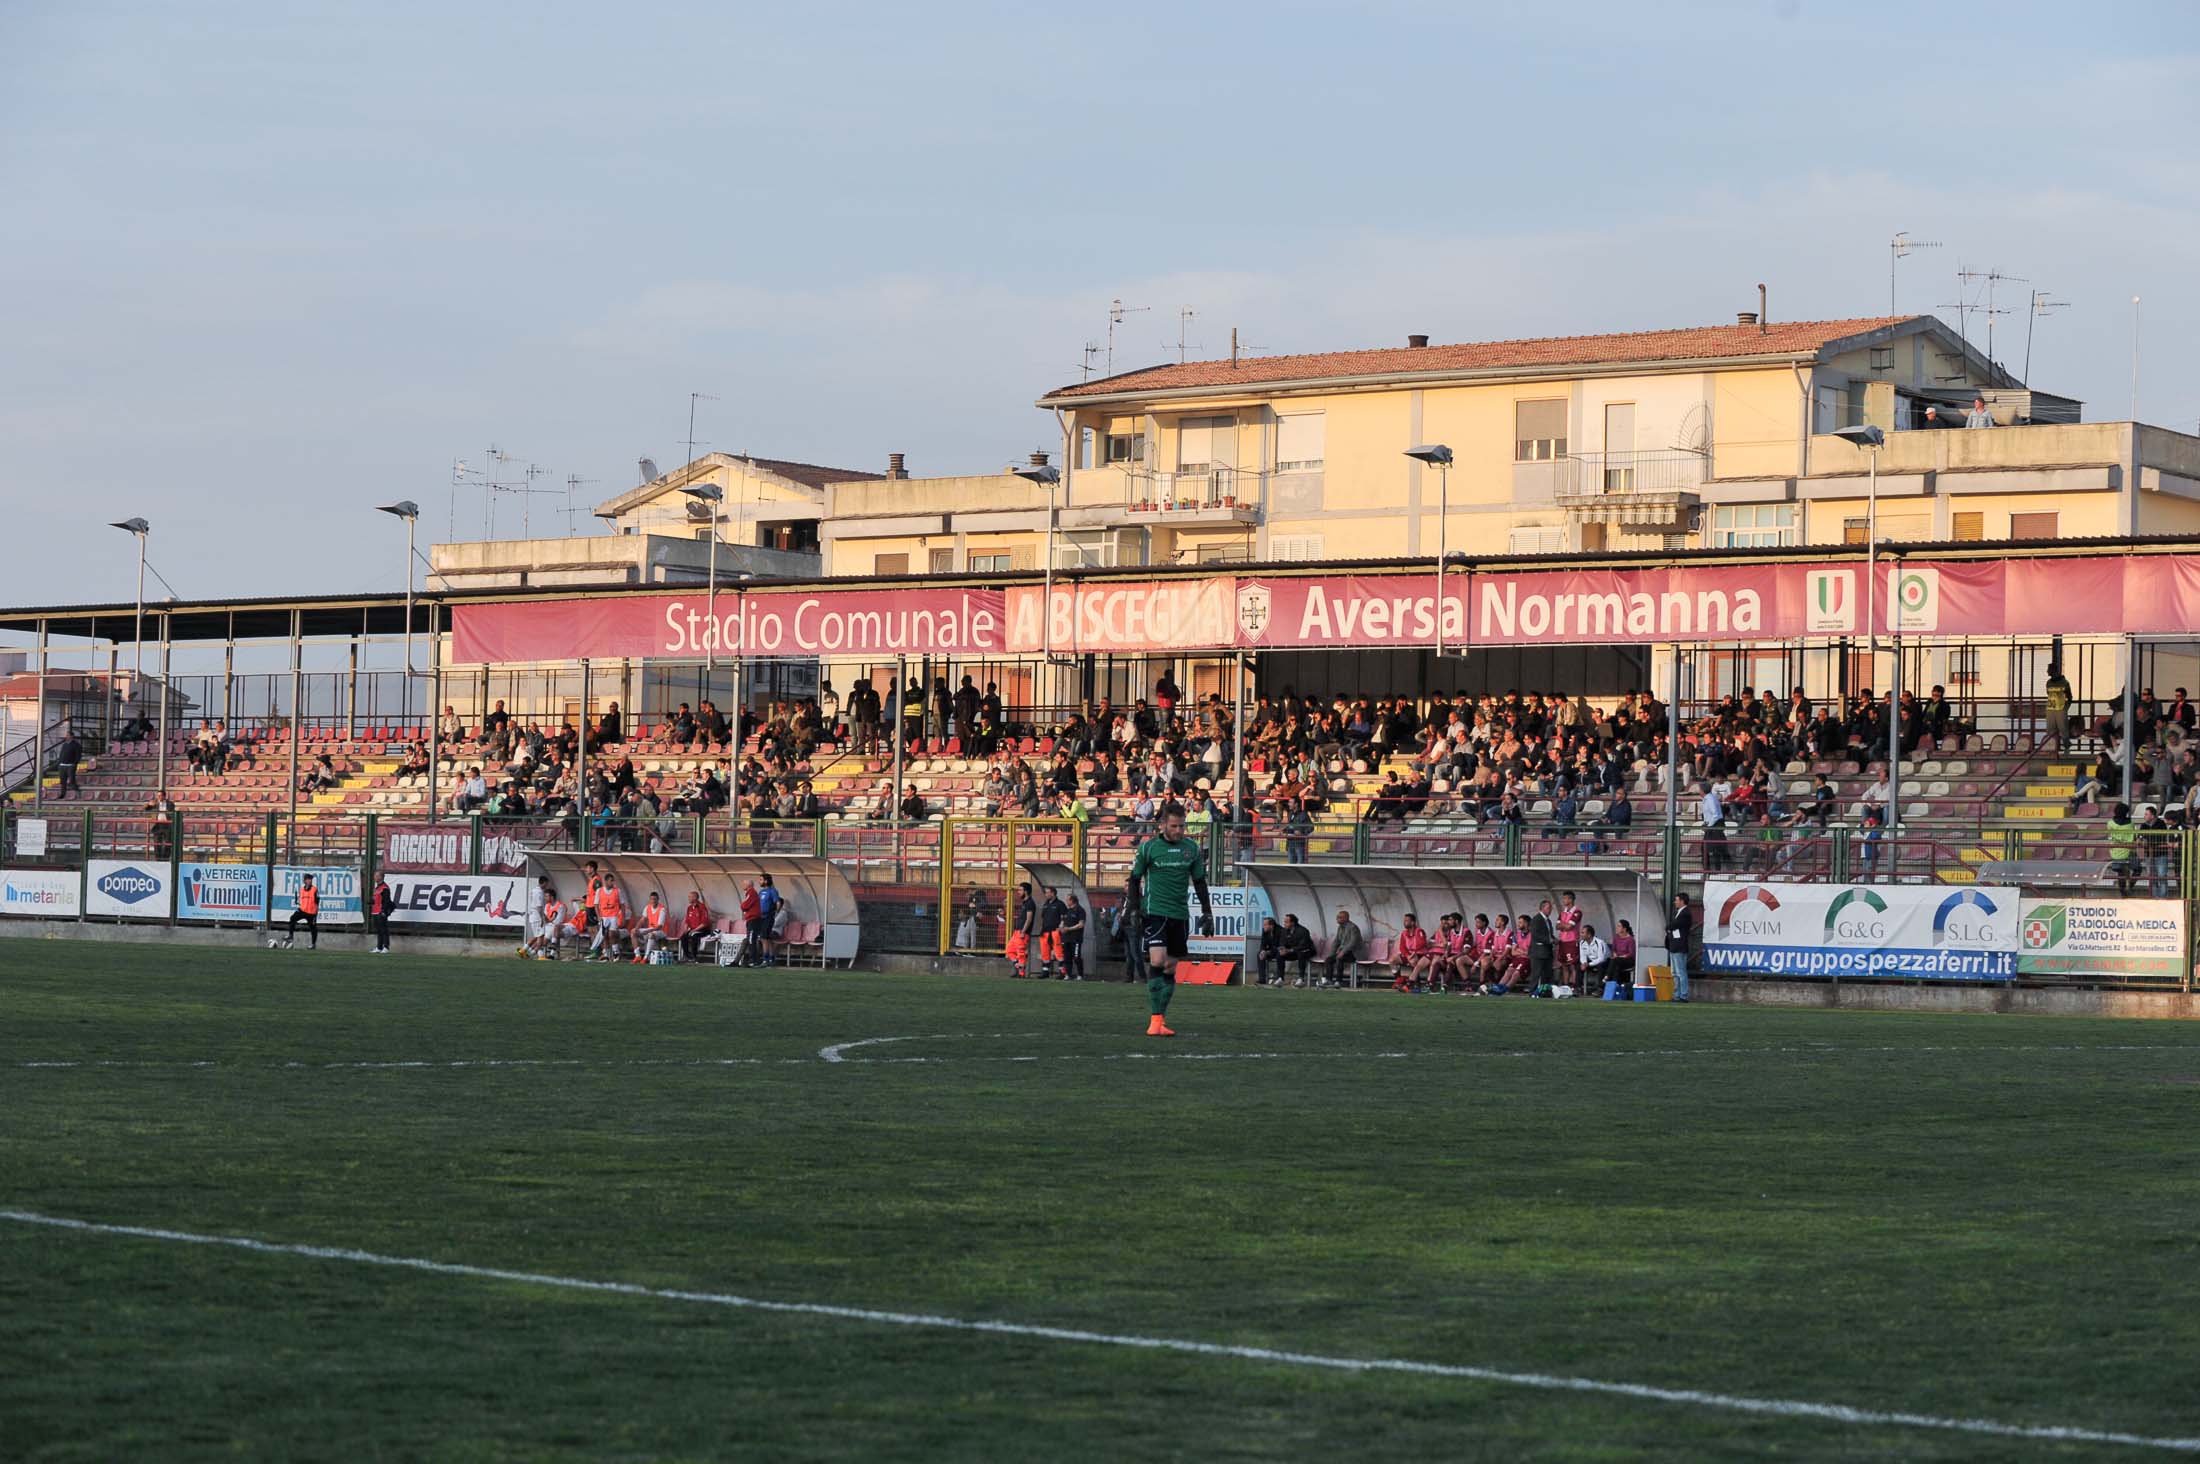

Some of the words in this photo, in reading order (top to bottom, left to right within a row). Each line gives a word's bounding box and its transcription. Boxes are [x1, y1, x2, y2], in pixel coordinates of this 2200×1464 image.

[1298, 585, 1465, 640] Aversa
[1480, 582, 1761, 637] Normanna
[665, 598, 783, 652] Stadio
[793, 594, 995, 650] Comunale
[390, 834, 457, 865] ORGOGLIO
[205, 868, 258, 881] VETRERIA
[104, 876, 156, 893] pompea
[393, 883, 492, 912] LEGEA
[2068, 907, 2105, 917] STUDIO
[2107, 908, 2117, 917] DI
[1733, 919, 1781, 936] SEVIM
[1838, 921, 1884, 939] G&G
[1948, 923, 1998, 942] S.L.G.
[2068, 919, 2134, 929] RADIOLOGIA
[2136, 920, 2177, 930] MEDICA
[2068, 931, 2108, 941] AMATO
[1707, 949, 2012, 976] www.gruppospezzaferri.it
